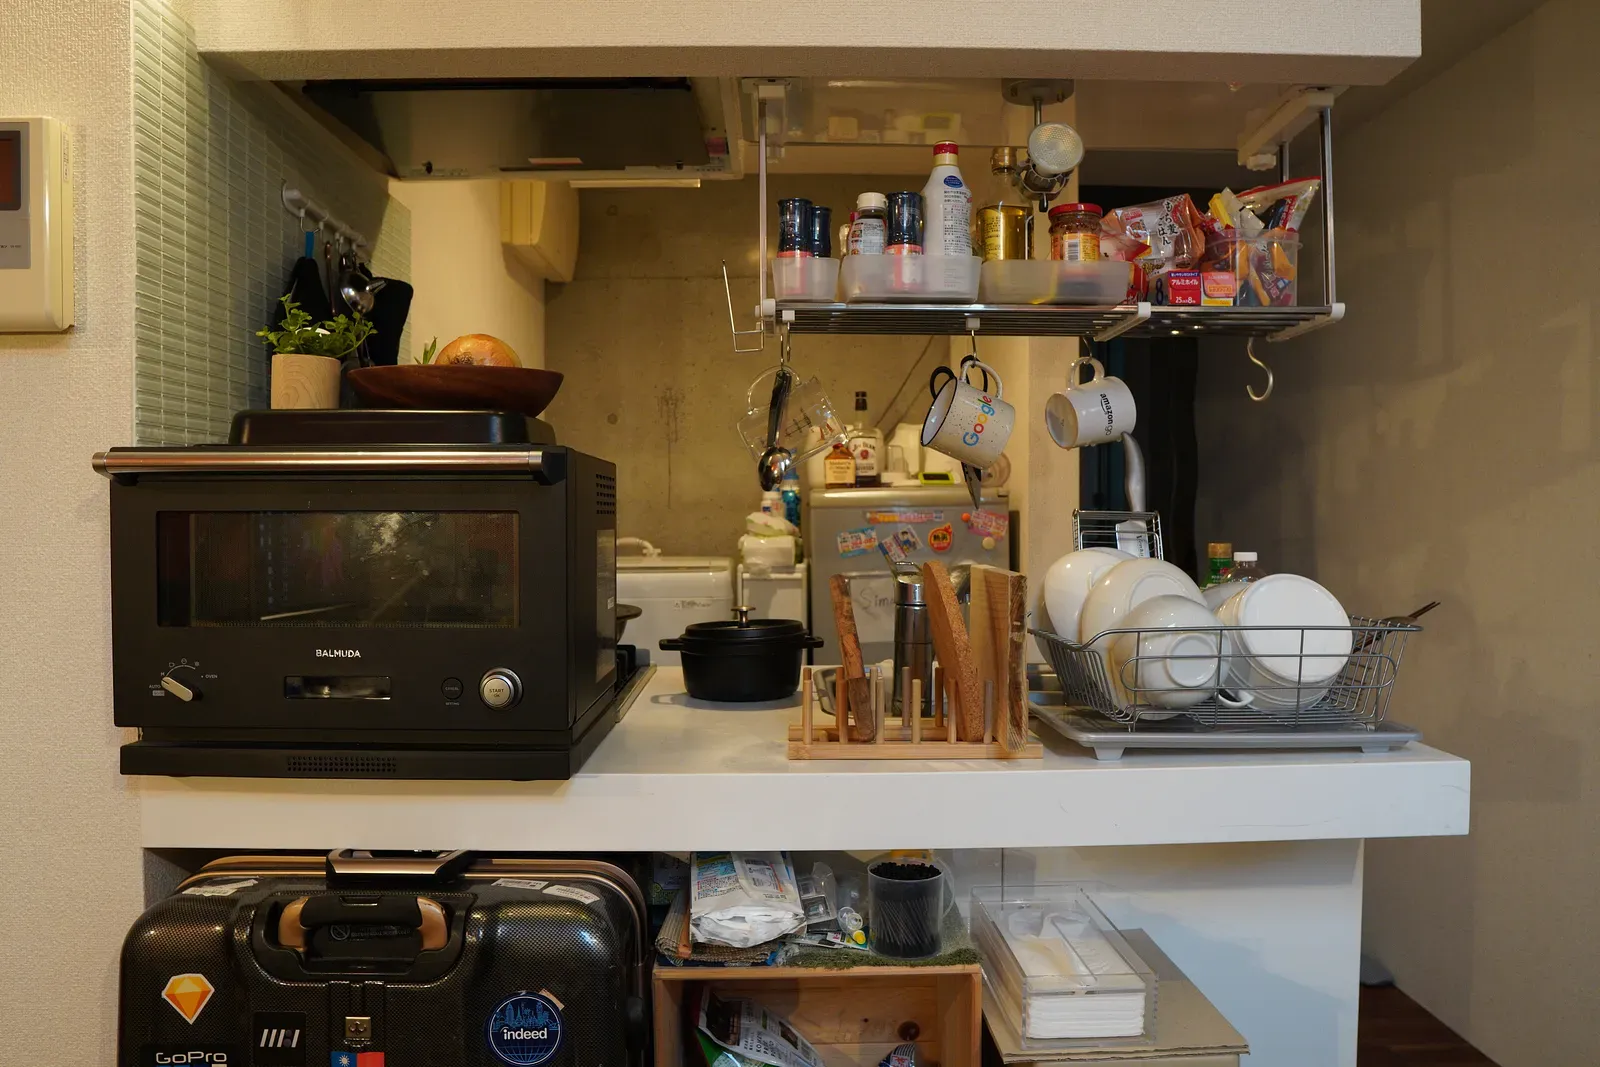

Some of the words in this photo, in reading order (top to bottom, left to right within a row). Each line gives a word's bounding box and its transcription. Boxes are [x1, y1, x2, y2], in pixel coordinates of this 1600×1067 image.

[1100, 393, 1113, 425] amazon
[963, 395, 995, 446] Google
[315, 649, 362, 658] BALMUDA
[502, 1027, 548, 1041] indeed
[155, 1051, 227, 1064] GoPro
